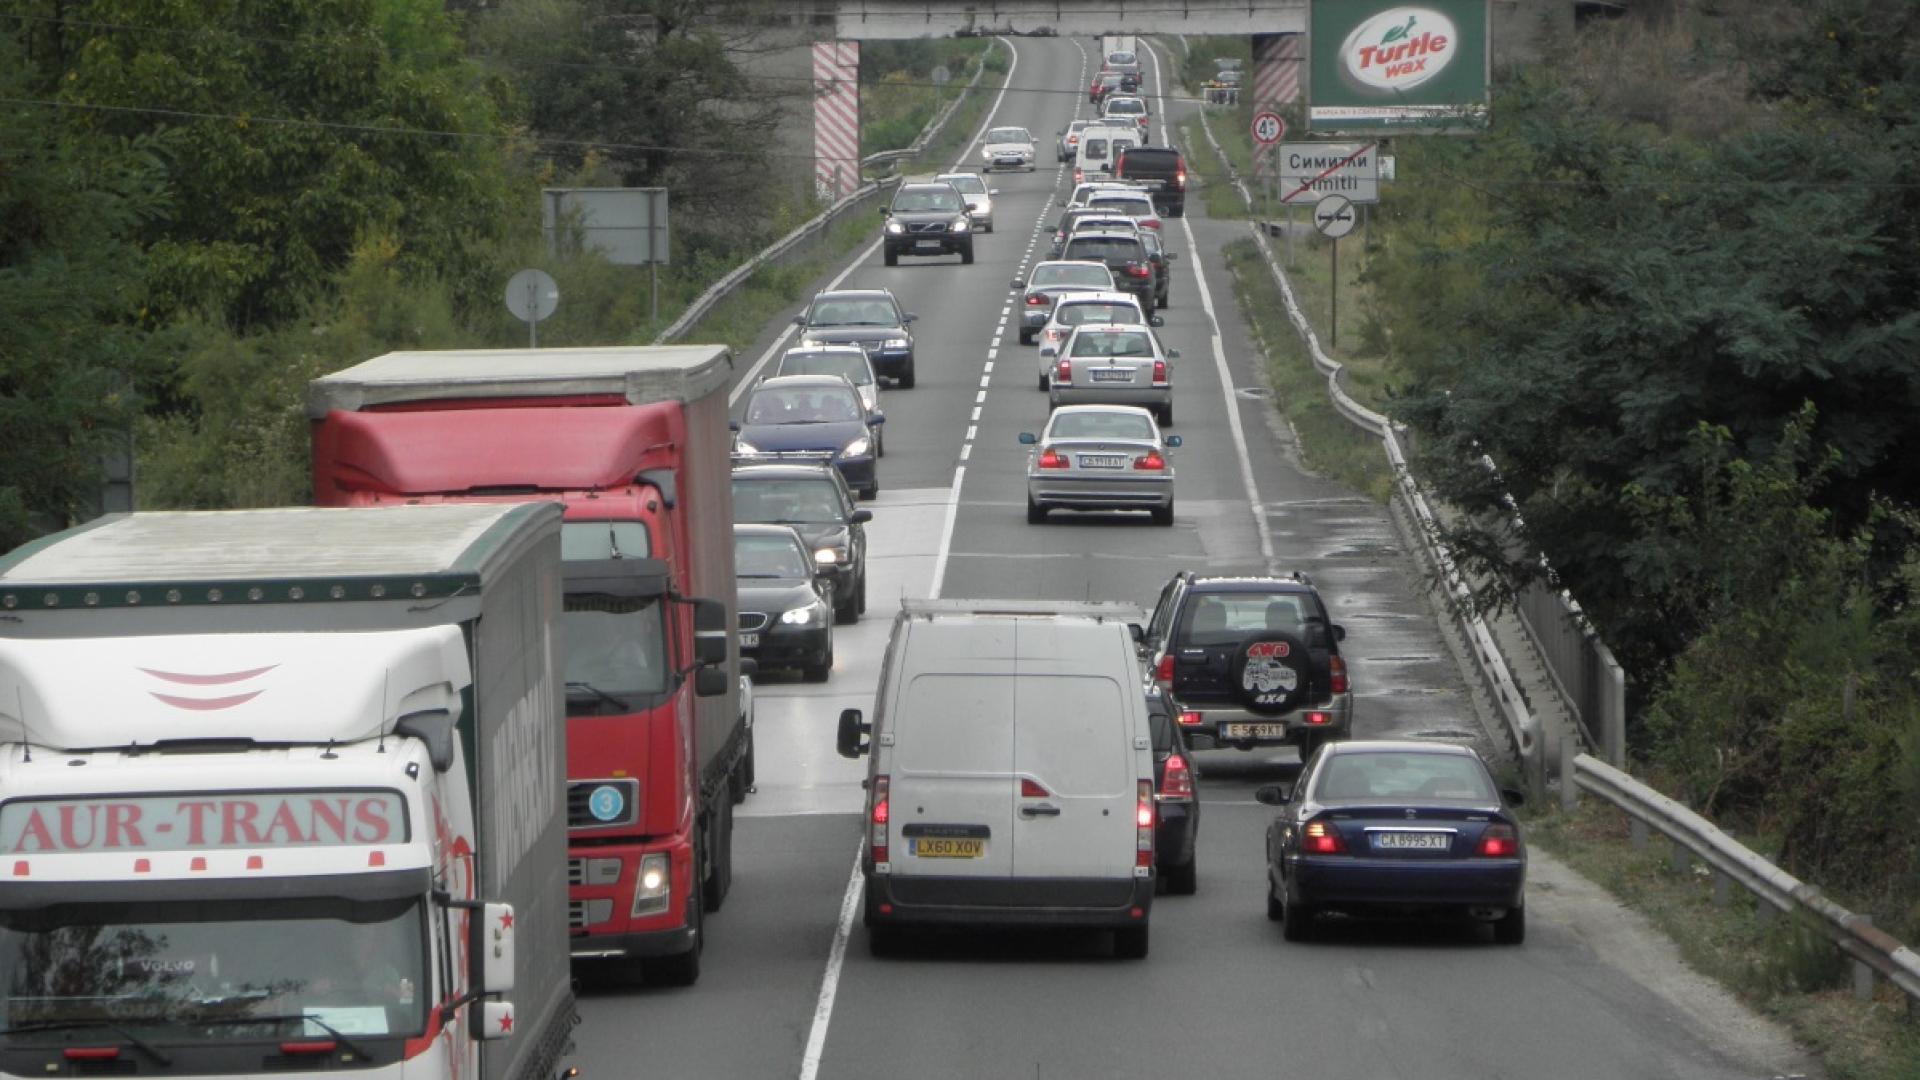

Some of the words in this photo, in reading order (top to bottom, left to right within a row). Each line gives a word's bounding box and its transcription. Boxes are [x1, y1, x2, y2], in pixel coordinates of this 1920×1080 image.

[1359, 31, 1448, 69] Turtle
[1385, 58, 1427, 78] wax
[1290, 153, 1367, 169] Симитли
[1300, 176, 1358, 191] Simitli
[1247, 642, 1290, 657] 4WD
[601, 793, 614, 813] 3
[12, 798, 392, 853] AUR-TRANS
[918, 840, 952, 854] LX60
[1381, 833, 1395, 846] CA
[141, 960, 195, 972] VOLVO
